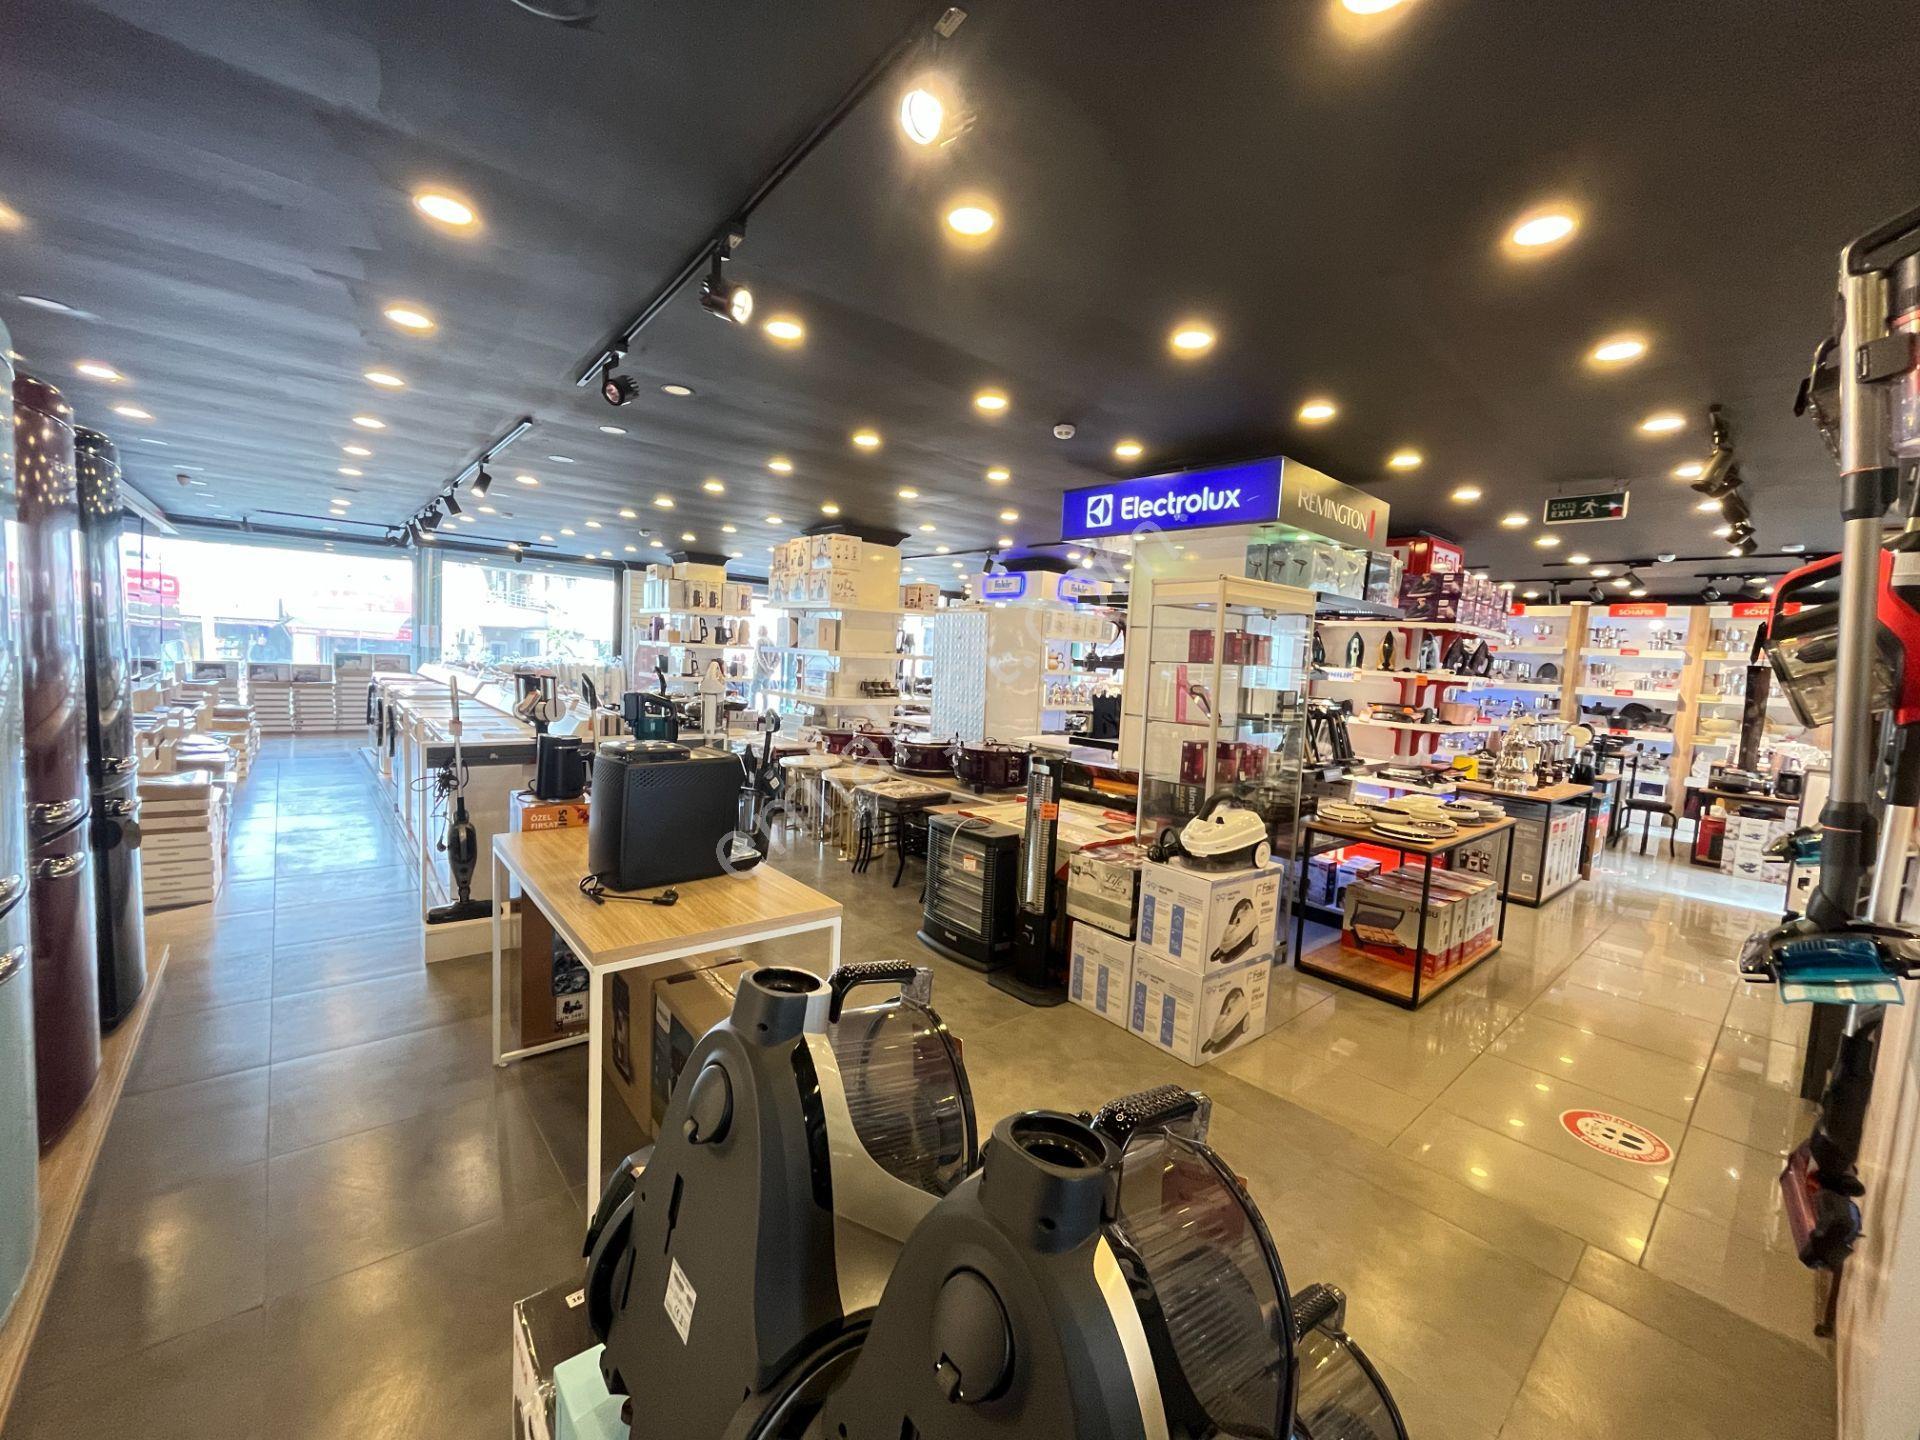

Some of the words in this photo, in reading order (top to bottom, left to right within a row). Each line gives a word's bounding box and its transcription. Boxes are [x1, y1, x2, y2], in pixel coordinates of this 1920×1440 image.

[1120, 486, 1241, 520] Electrolux
[1298, 487, 1368, 533] REMINGTON
[1551, 509, 1576, 518] EXIT
[1433, 550, 1459, 573] Tefal
[530, 813, 552, 822] ÖZEL
[572, 1295, 583, 1303] 16
